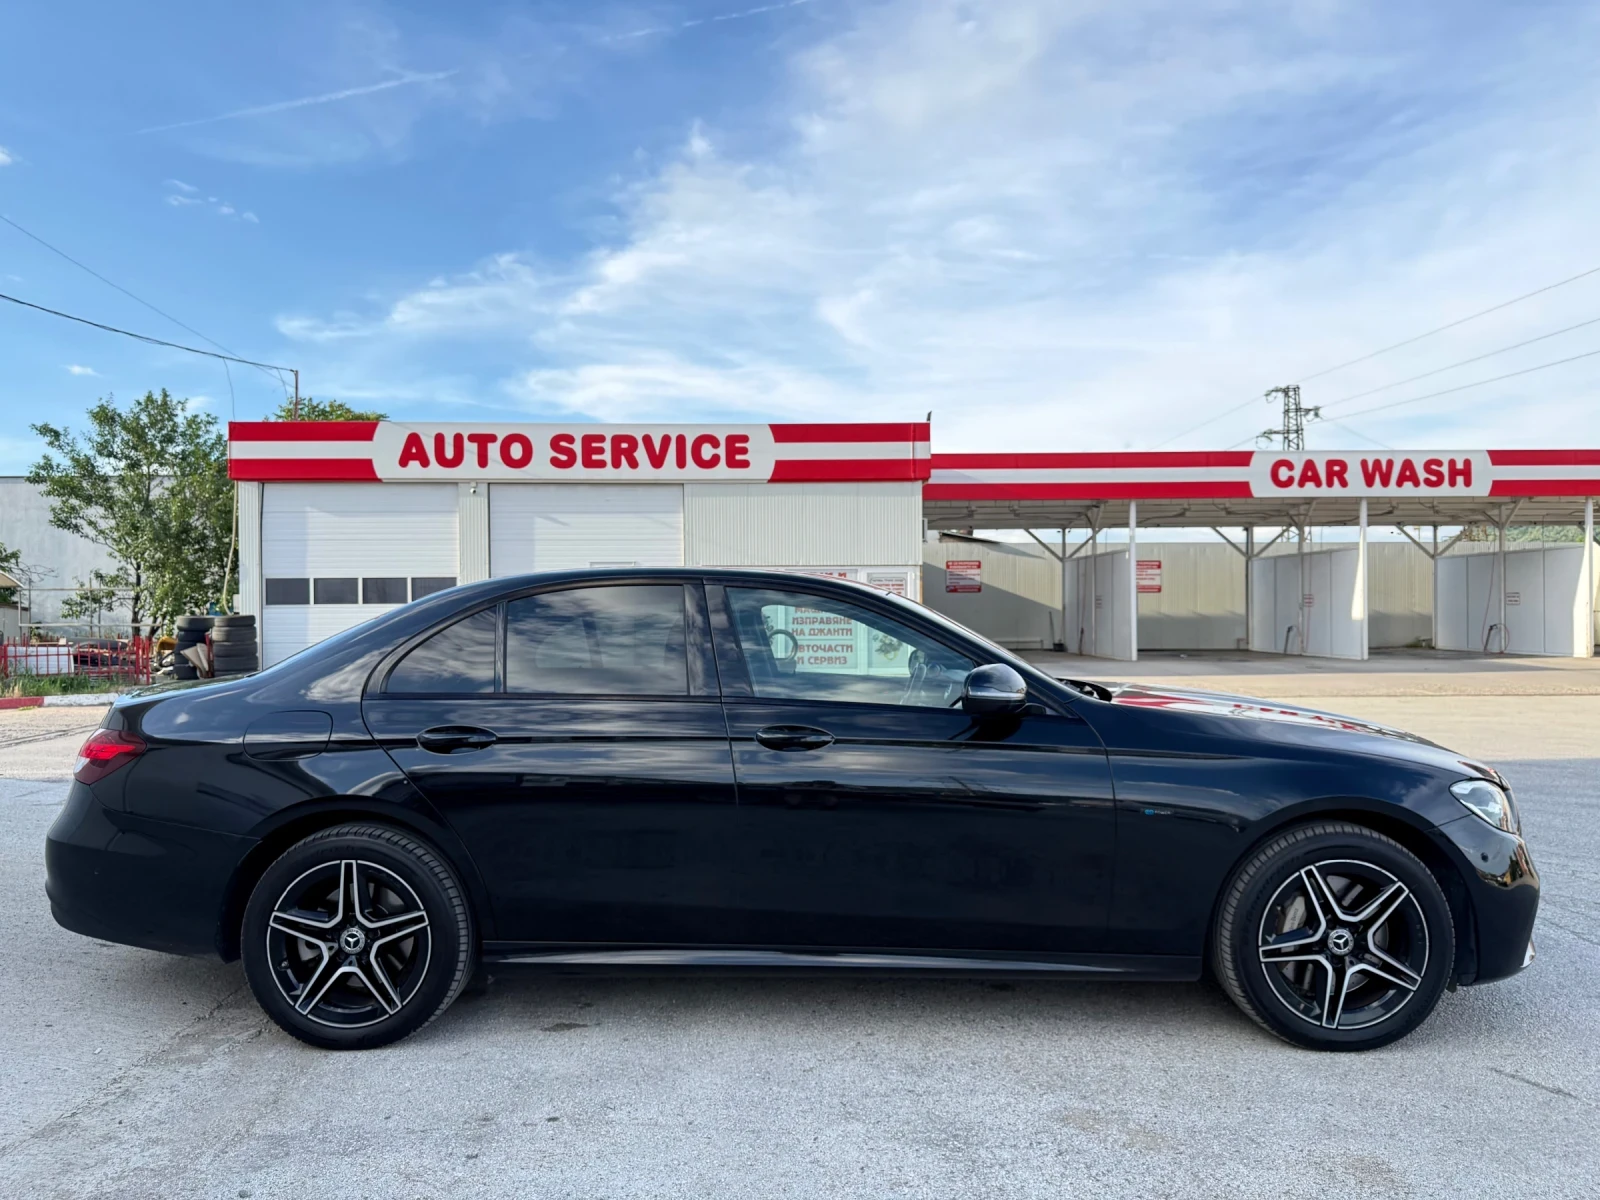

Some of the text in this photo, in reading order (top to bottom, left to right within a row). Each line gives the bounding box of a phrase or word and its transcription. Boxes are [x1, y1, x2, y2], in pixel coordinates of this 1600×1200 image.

[398, 432, 751, 470] AUTO SERVICE
[1270, 458, 1473, 489] CAR WASH
[792, 616, 853, 625] ИЗПРАВЯНЕ
[791, 628, 853, 636] НА ДЖАНТИ
[797, 656, 848, 665] И СЕРВИЗ
